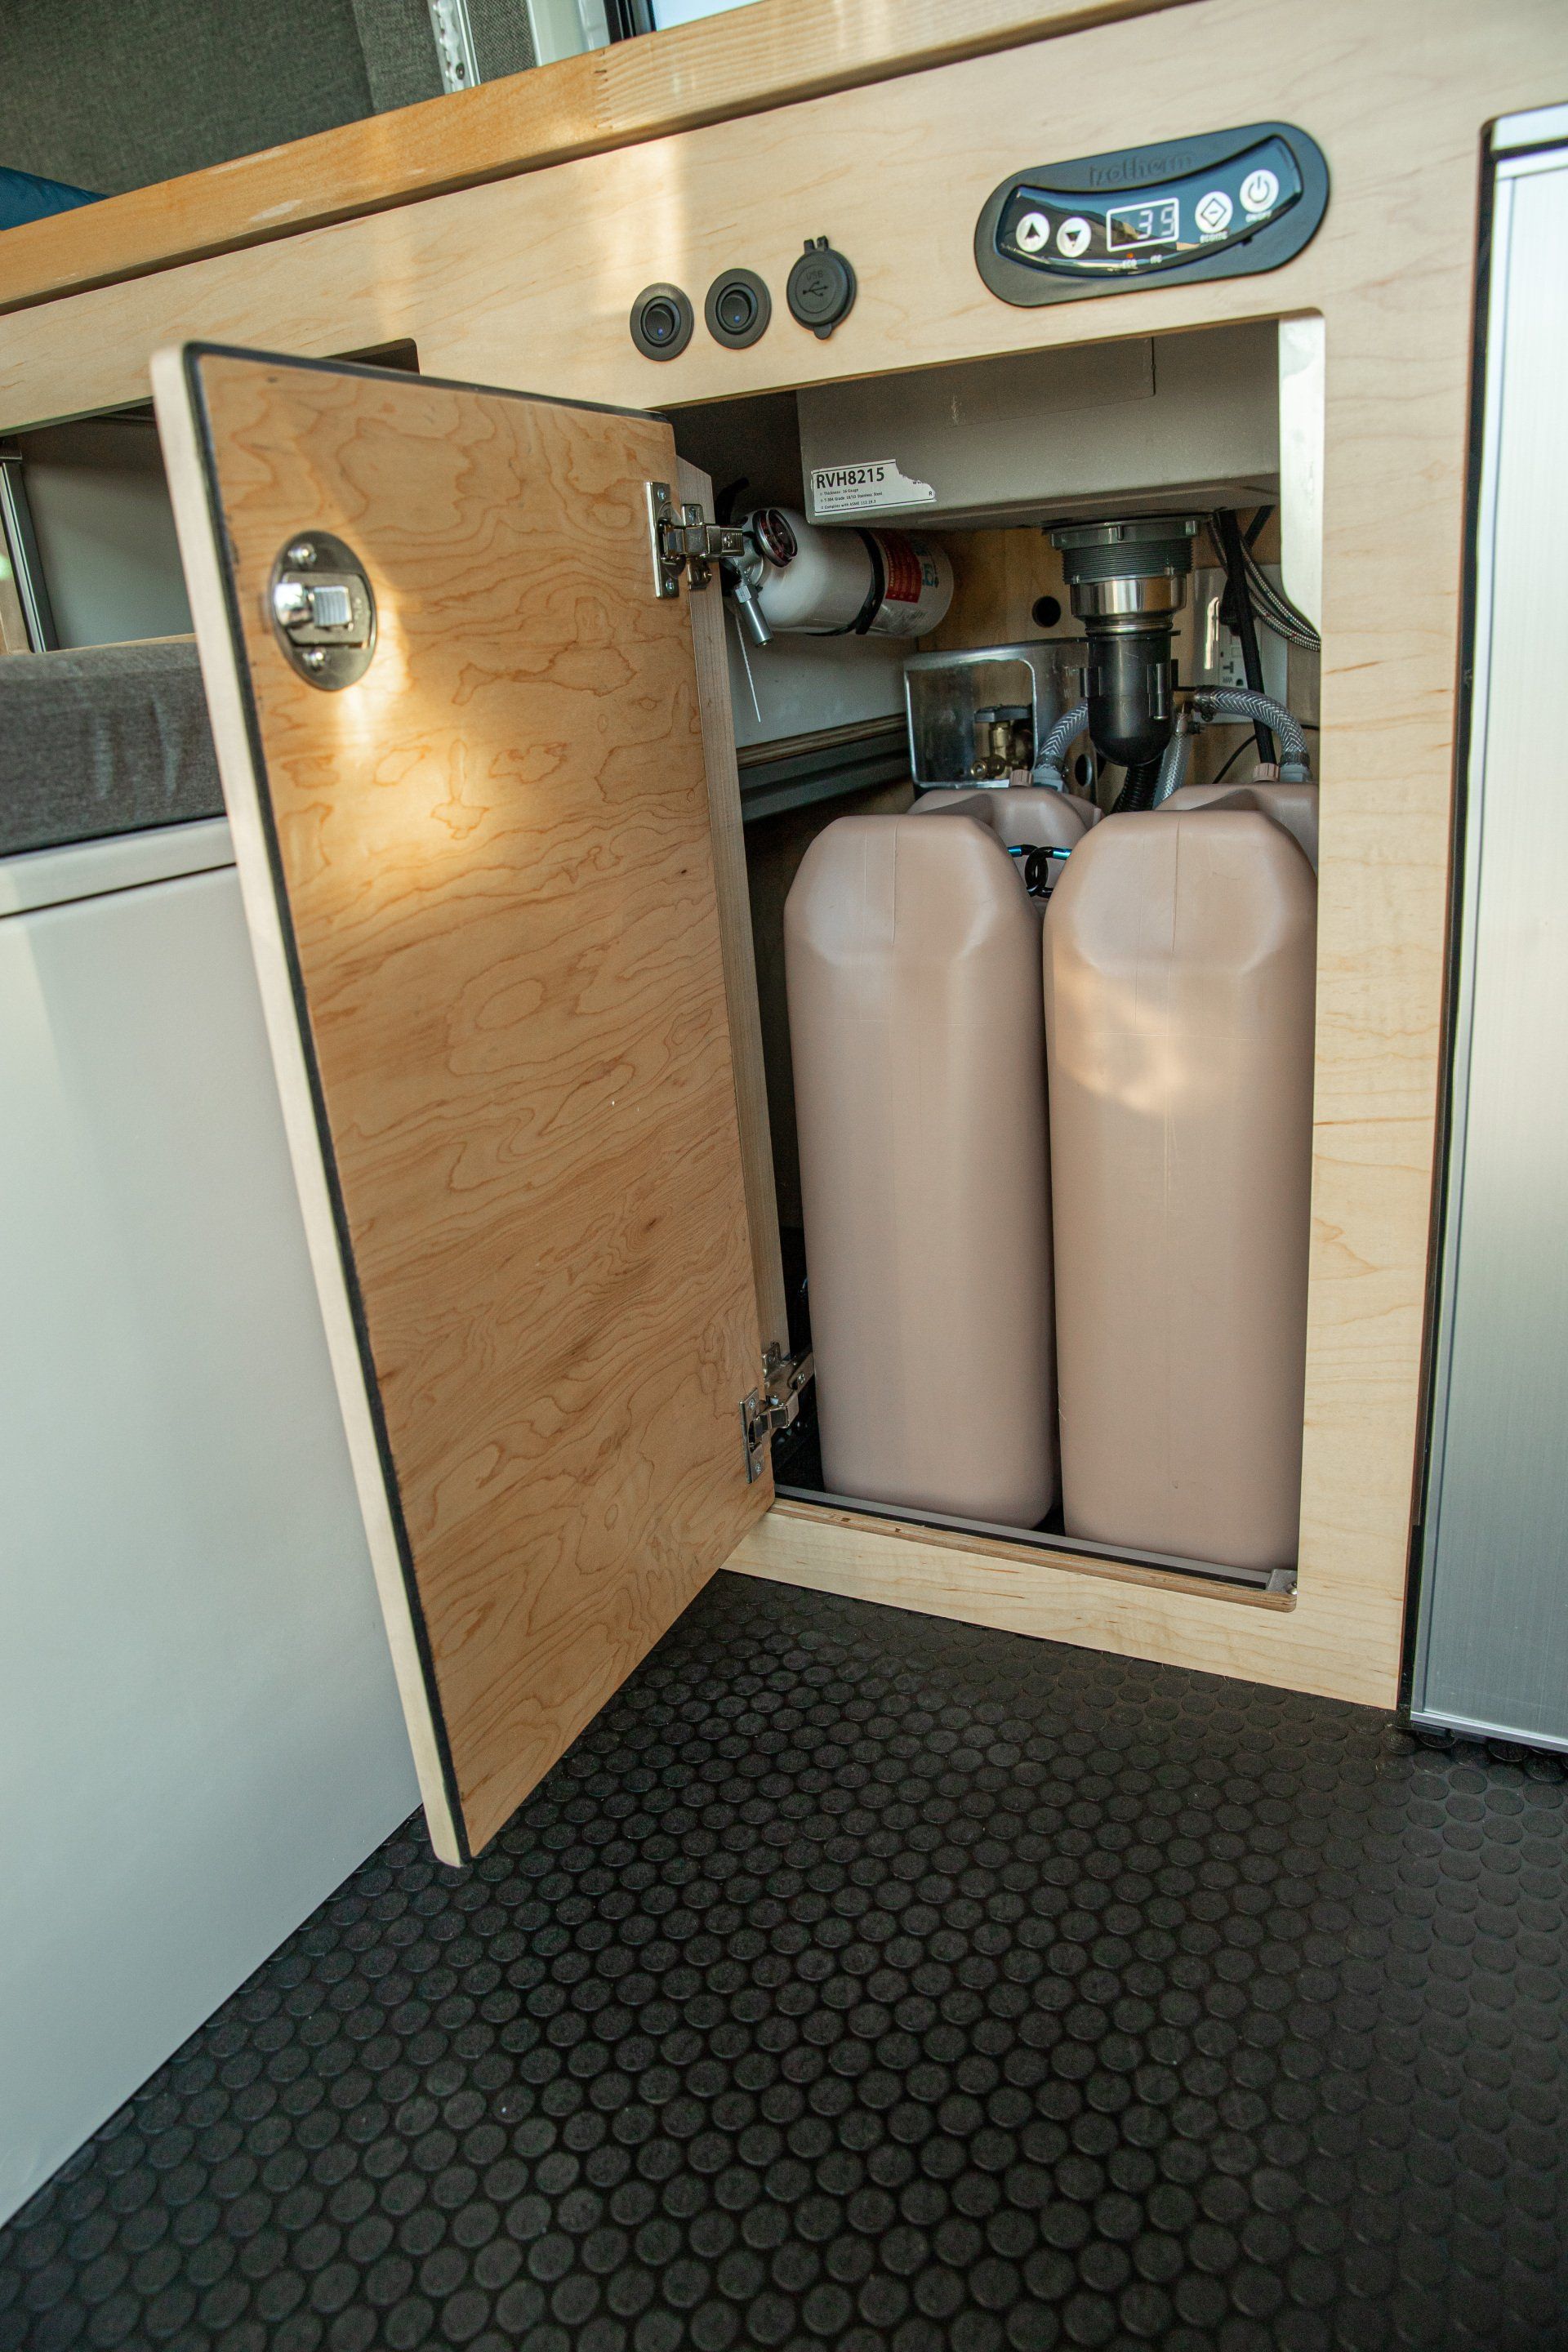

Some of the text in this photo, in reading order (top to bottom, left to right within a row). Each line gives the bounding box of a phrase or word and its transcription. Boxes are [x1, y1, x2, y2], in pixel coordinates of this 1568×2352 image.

[1136, 207, 1174, 240] 39
[805, 270, 824, 282] USB
[816, 466, 885, 489] RVH8215
